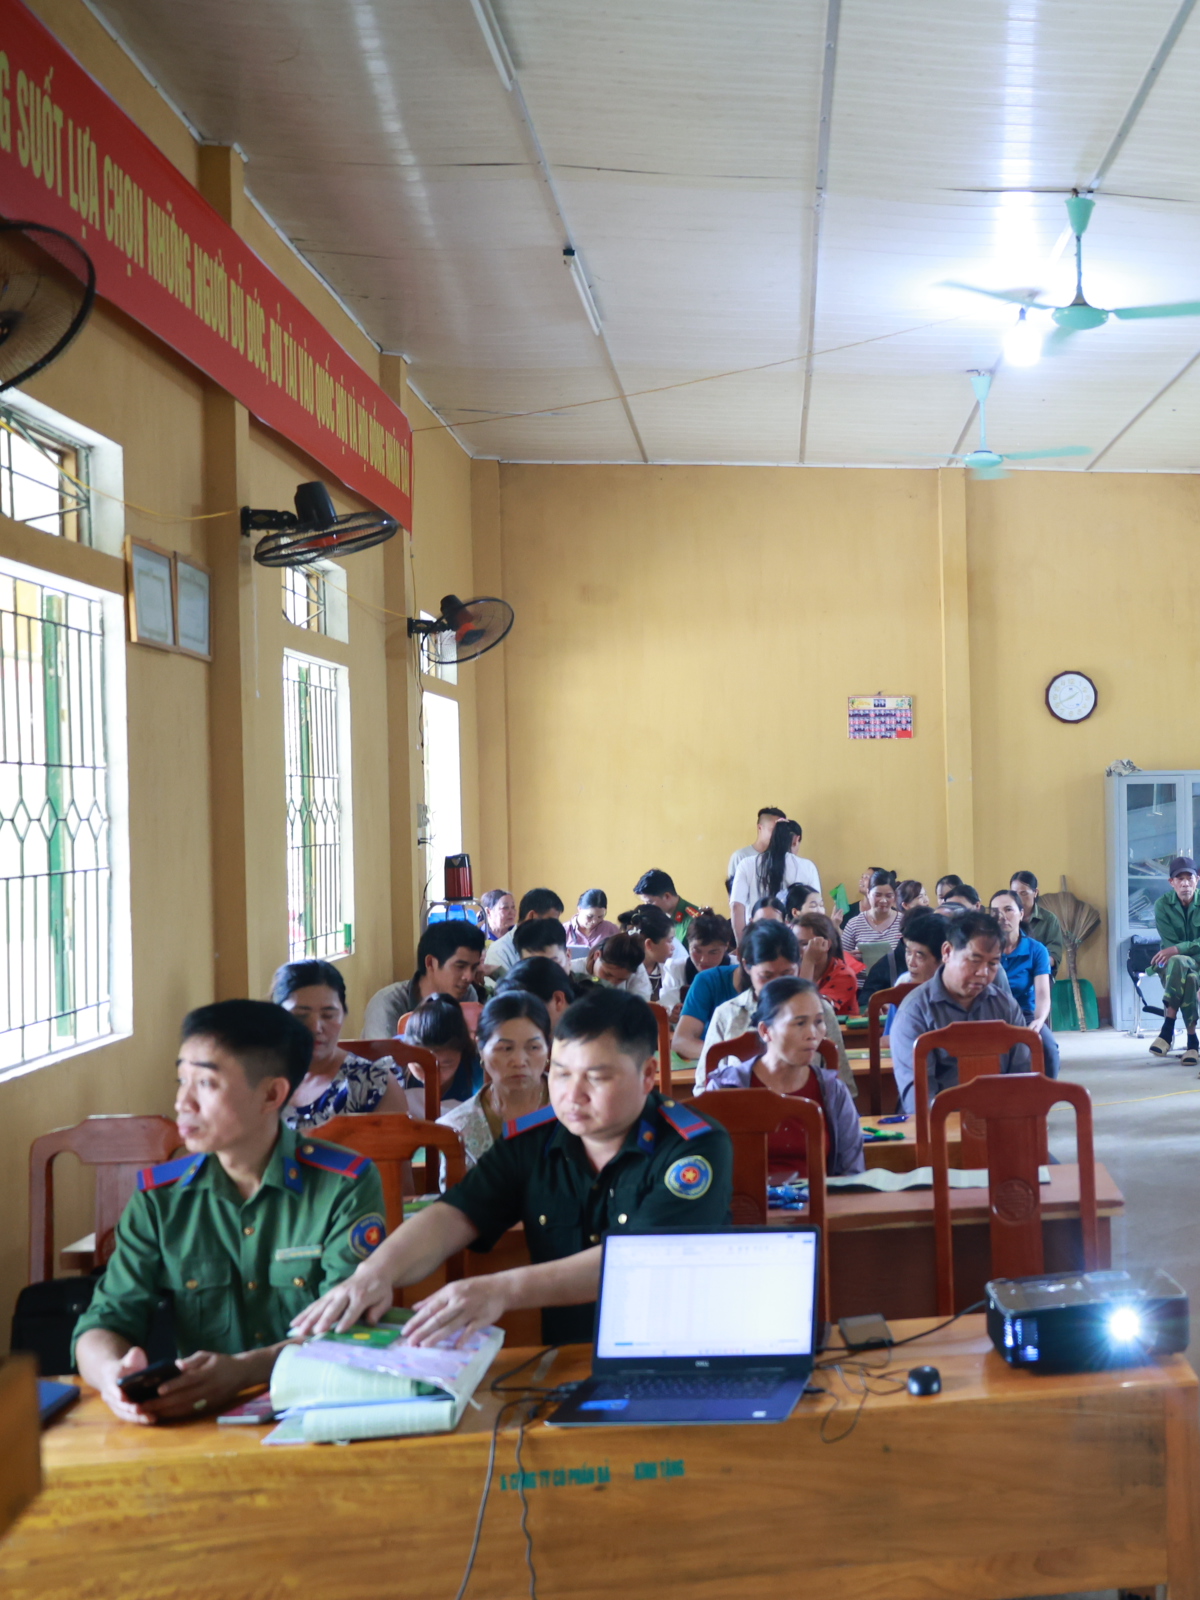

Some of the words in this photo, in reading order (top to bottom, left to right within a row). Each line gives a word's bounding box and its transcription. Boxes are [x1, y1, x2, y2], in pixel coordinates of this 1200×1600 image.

[17, 66, 63, 198] SUỐT
[67, 118, 100, 239] LỰA
[103, 154, 144, 277] CHỌN
[147, 196, 192, 310] NHỮNG
[194, 242, 229, 342] NGƯỜI
[230, 263, 245, 356] ĐỦ
[246, 288, 269, 386] ĐỨC,
[269, 303, 283, 389] ĐỦ
[284, 322, 298, 402] TÀI
[298, 338, 314, 416] VÀO
[315, 353, 336, 434] QUỐC
[336, 375, 348, 455] HỘI
